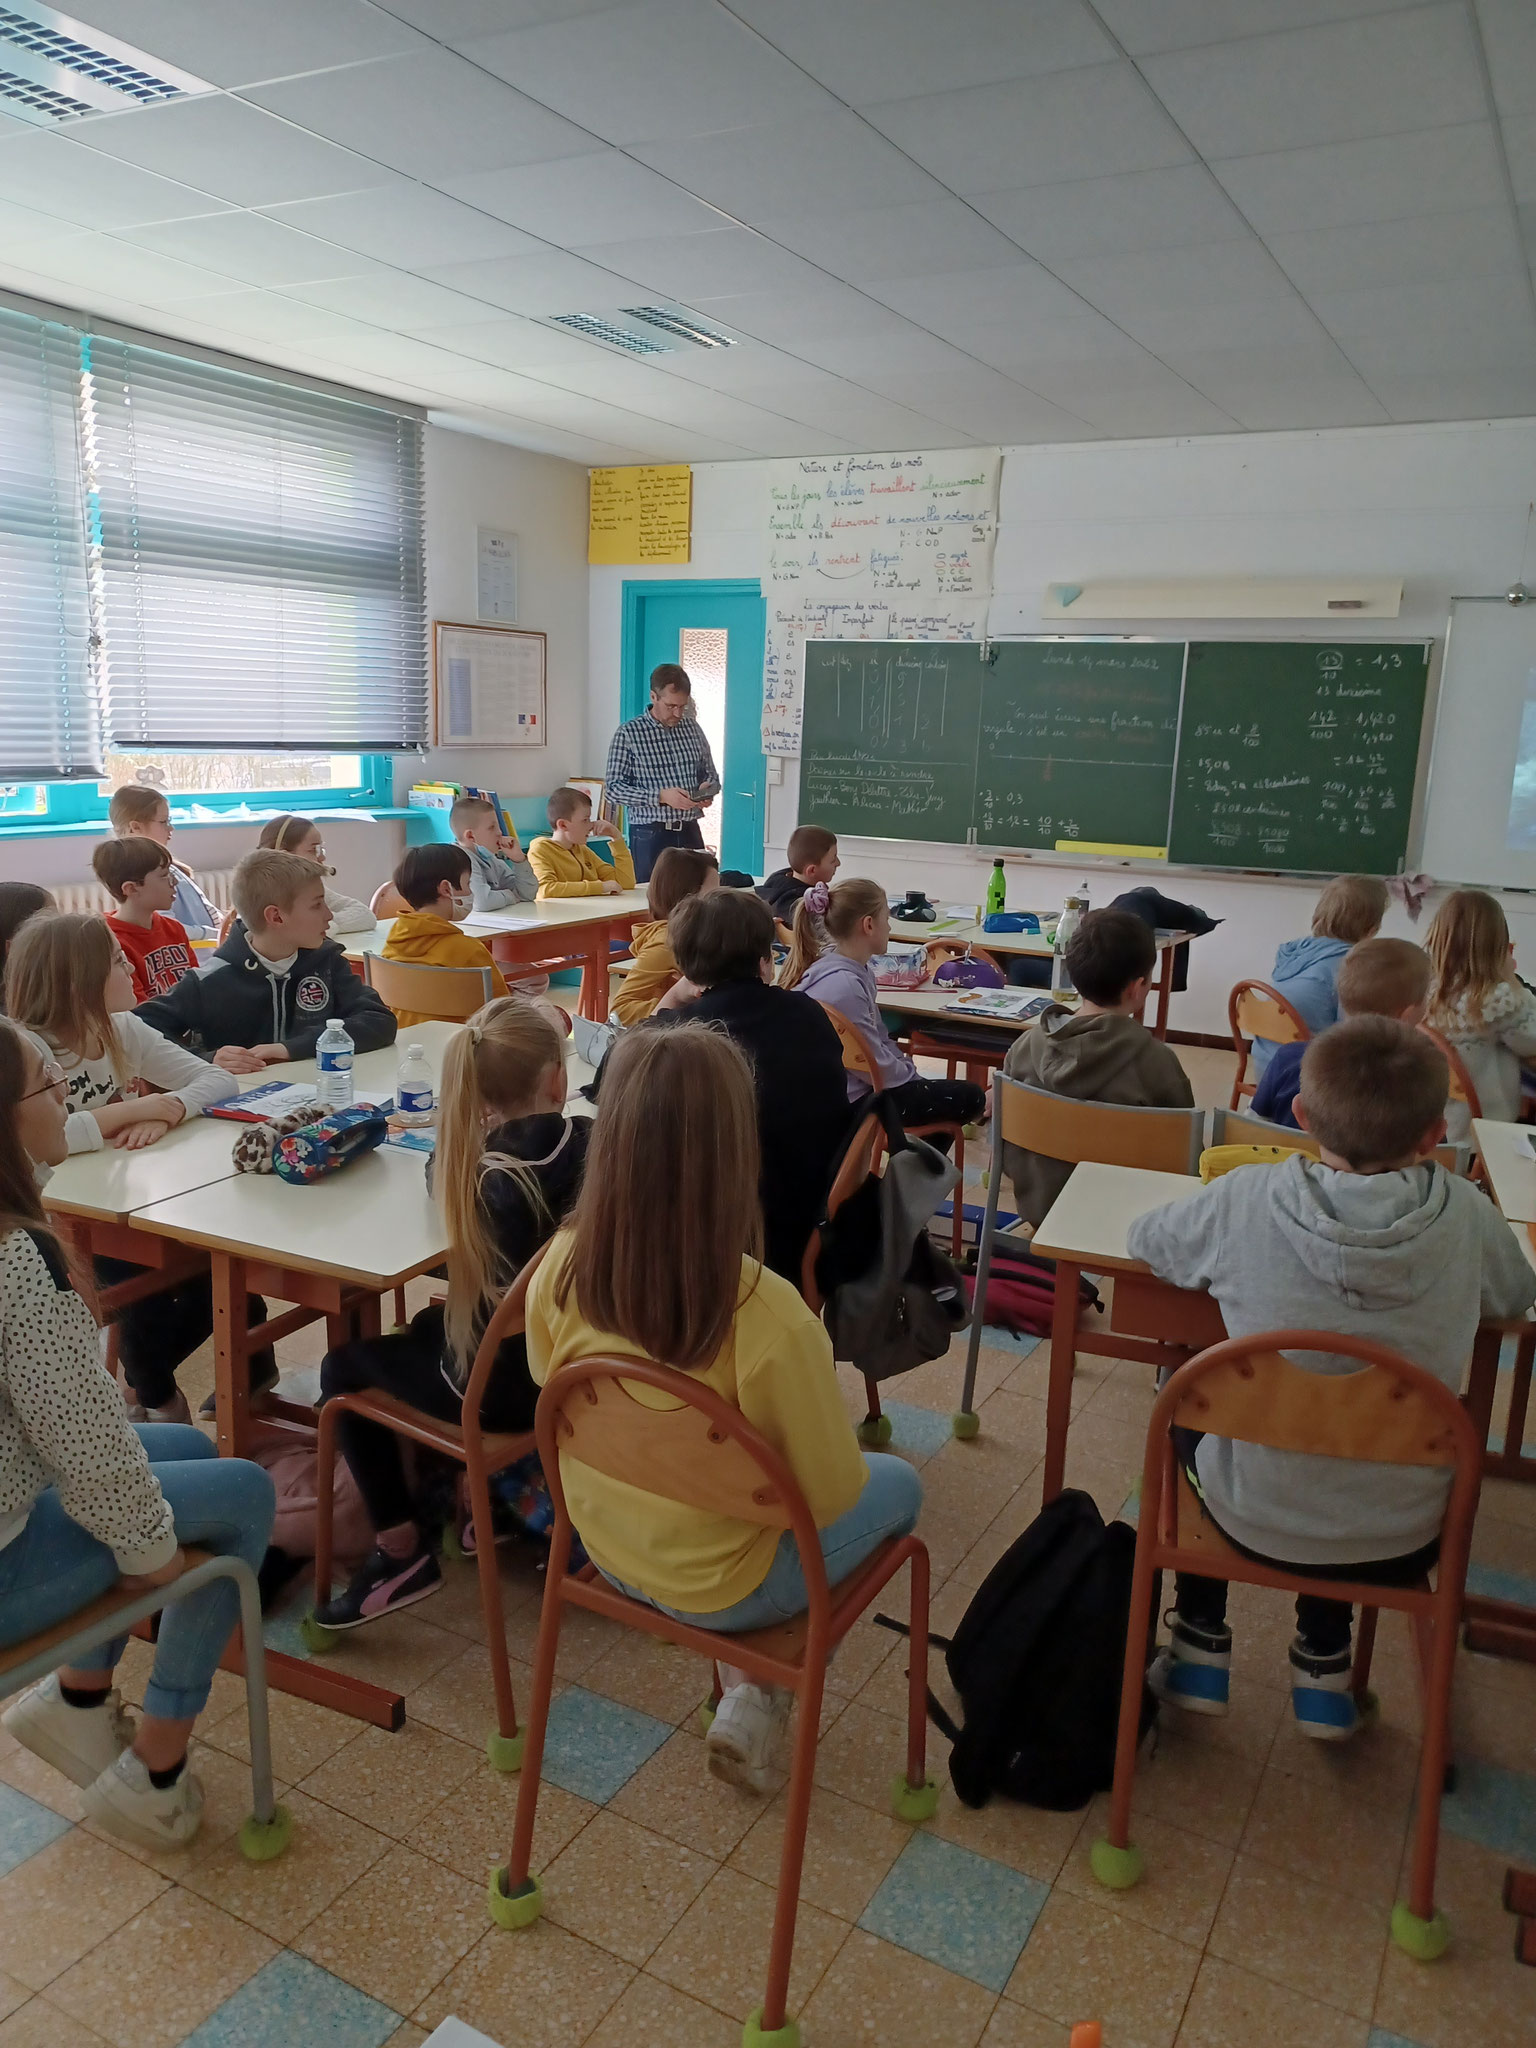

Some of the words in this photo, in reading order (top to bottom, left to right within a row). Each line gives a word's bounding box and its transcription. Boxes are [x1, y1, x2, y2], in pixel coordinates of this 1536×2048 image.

[833, 460, 844, 472] et
[846, 457, 885, 478] fonction
[890, 457, 902, 469] des
[826, 480, 838, 498] les
[842, 613, 876, 630] Imparfait
[1371, 653, 1402, 671] 1,3
[1110, 710, 1154, 732] fraction
[1308, 709, 1337, 727] 142
[1310, 730, 1334, 740] 100
[1006, 791, 1024, 806] 0,3
[1037, 815, 1053, 825] 10
[1038, 827, 1052, 836] 10
